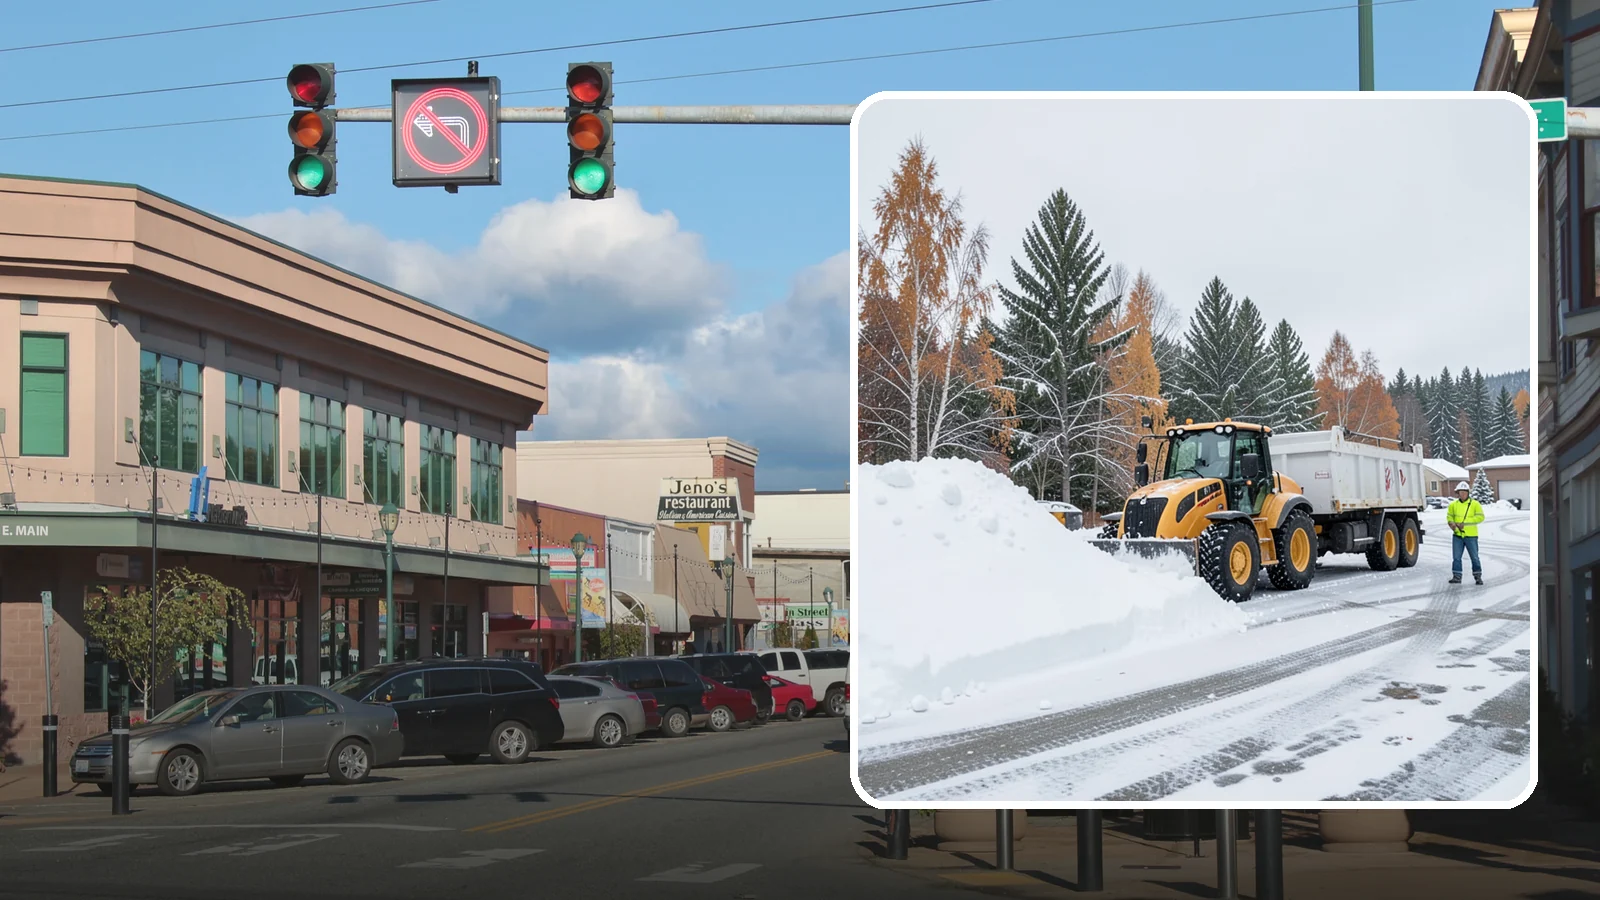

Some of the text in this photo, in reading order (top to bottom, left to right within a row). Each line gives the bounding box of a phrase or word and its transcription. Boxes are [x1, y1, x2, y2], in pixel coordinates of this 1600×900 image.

[670, 480, 727, 494] Jeno's
[665, 496, 731, 509] restaurant
[658, 509, 681, 519] Italian
[685, 509, 714, 519] American
[714, 509, 737, 519] Cuisine
[2, 525, 49, 536] E. MAIN
[797, 607, 828, 616] Street
[791, 619, 824, 627] lass
